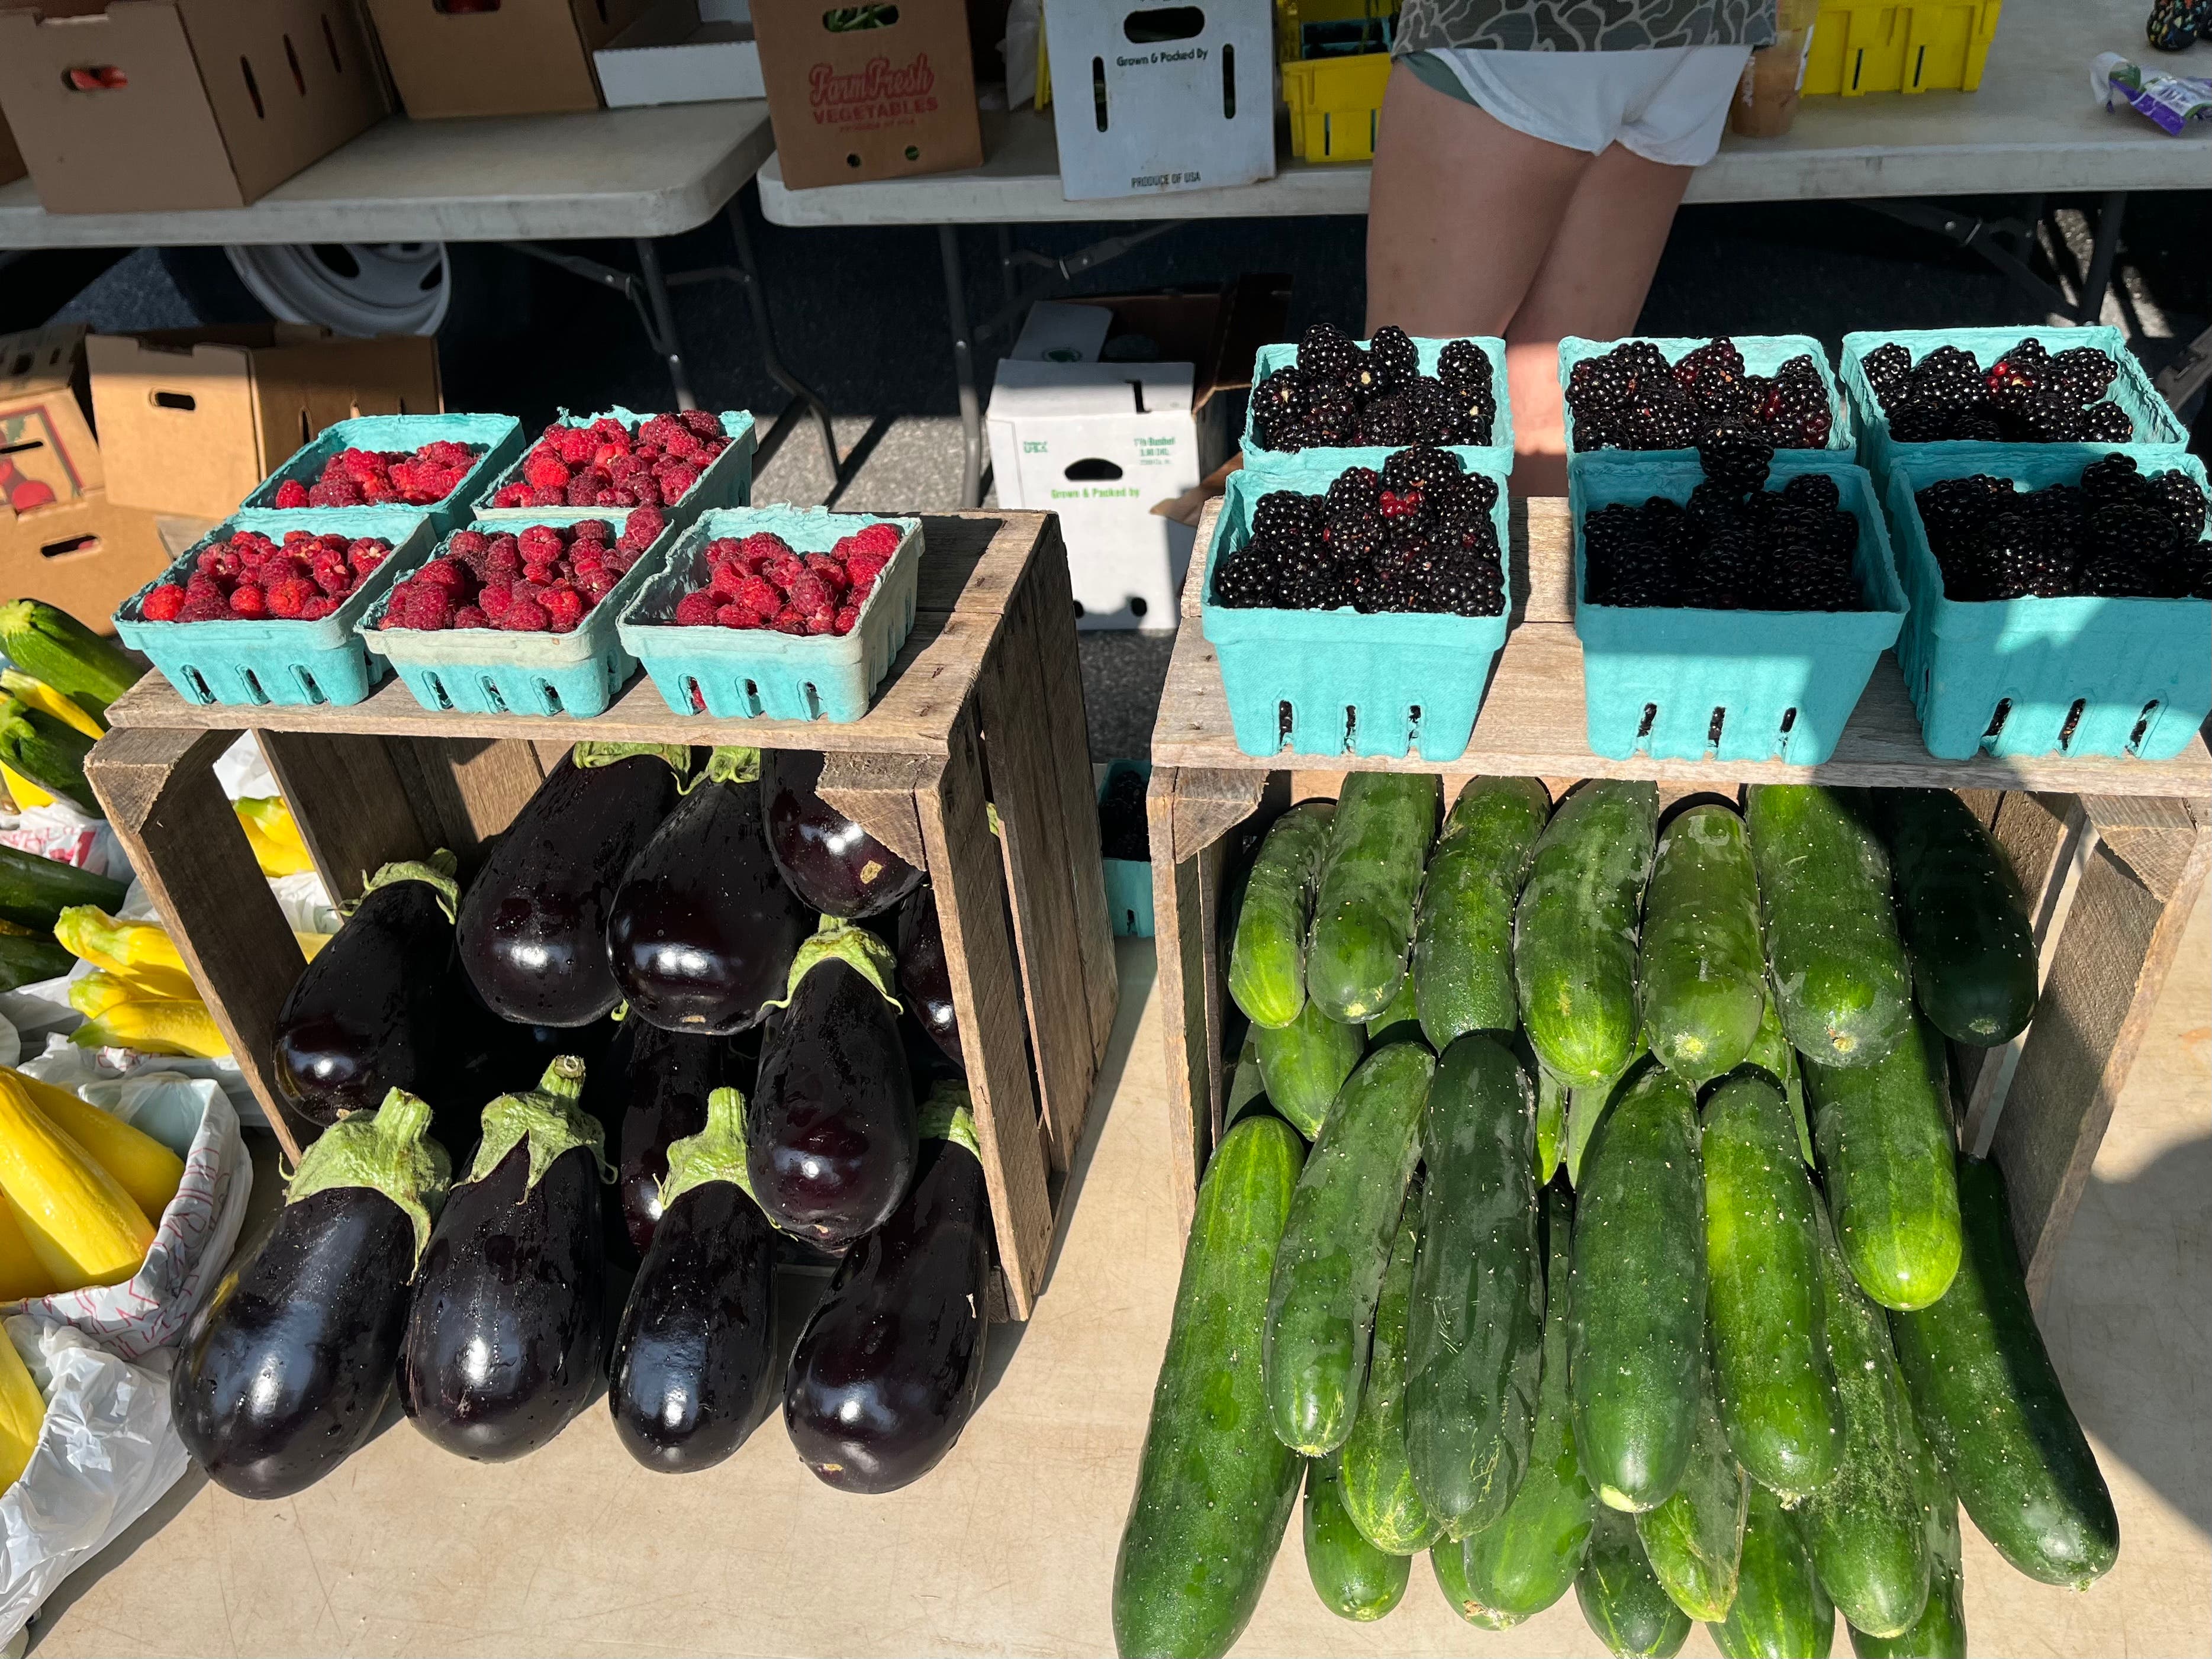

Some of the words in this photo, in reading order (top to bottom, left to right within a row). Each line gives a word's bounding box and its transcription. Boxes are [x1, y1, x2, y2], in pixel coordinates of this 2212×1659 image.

[1116, 56, 1149, 66] Grown
[1160, 49, 1194, 63] Packed
[813, 96, 938, 124] VEGETABLES
[1131, 175, 1170, 188] PRODUCE
[1171, 173, 1182, 183] OF
